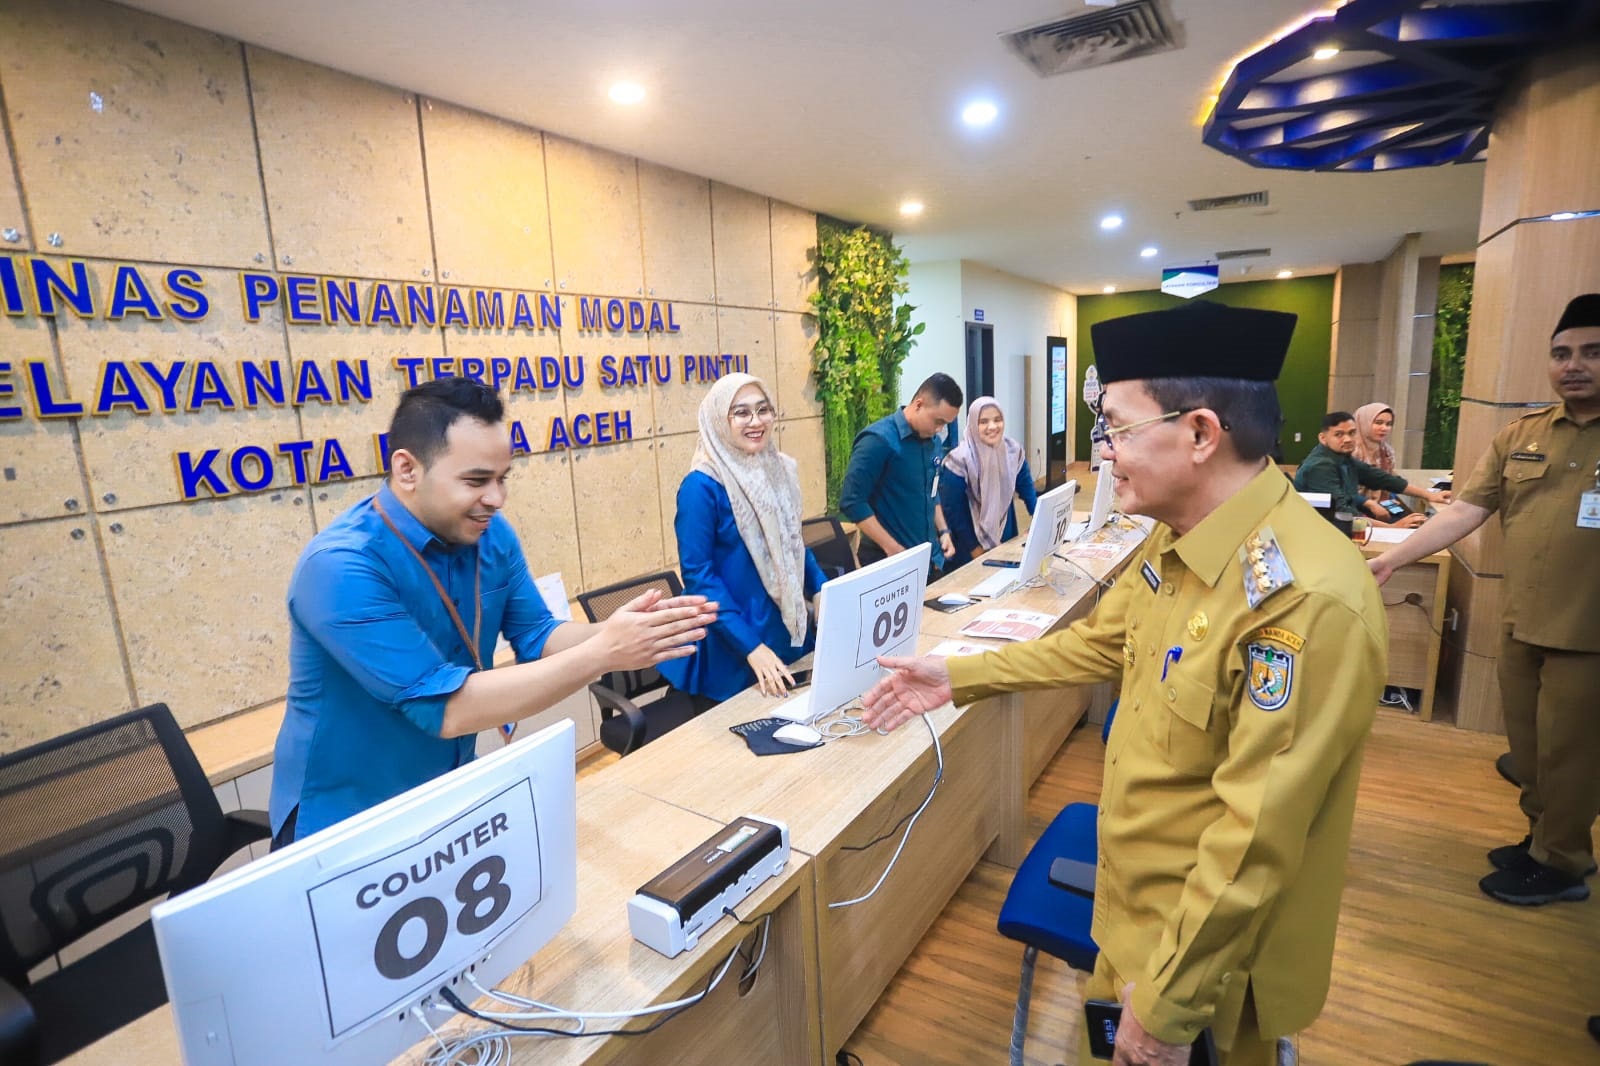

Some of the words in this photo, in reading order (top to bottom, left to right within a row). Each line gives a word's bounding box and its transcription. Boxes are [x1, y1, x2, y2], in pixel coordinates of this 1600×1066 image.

[240, 270, 562, 330] PENANAMAN
[576, 296, 681, 333] MODAL
[598, 354, 672, 387] SATU
[174, 437, 354, 501] KOTA
[545, 410, 633, 452] ACEH
[1053, 518, 1066, 545] 10
[874, 585, 909, 608] COUNTER
[873, 602, 908, 648] 09
[356, 812, 509, 909] COUNTER
[374, 855, 511, 980] 08
